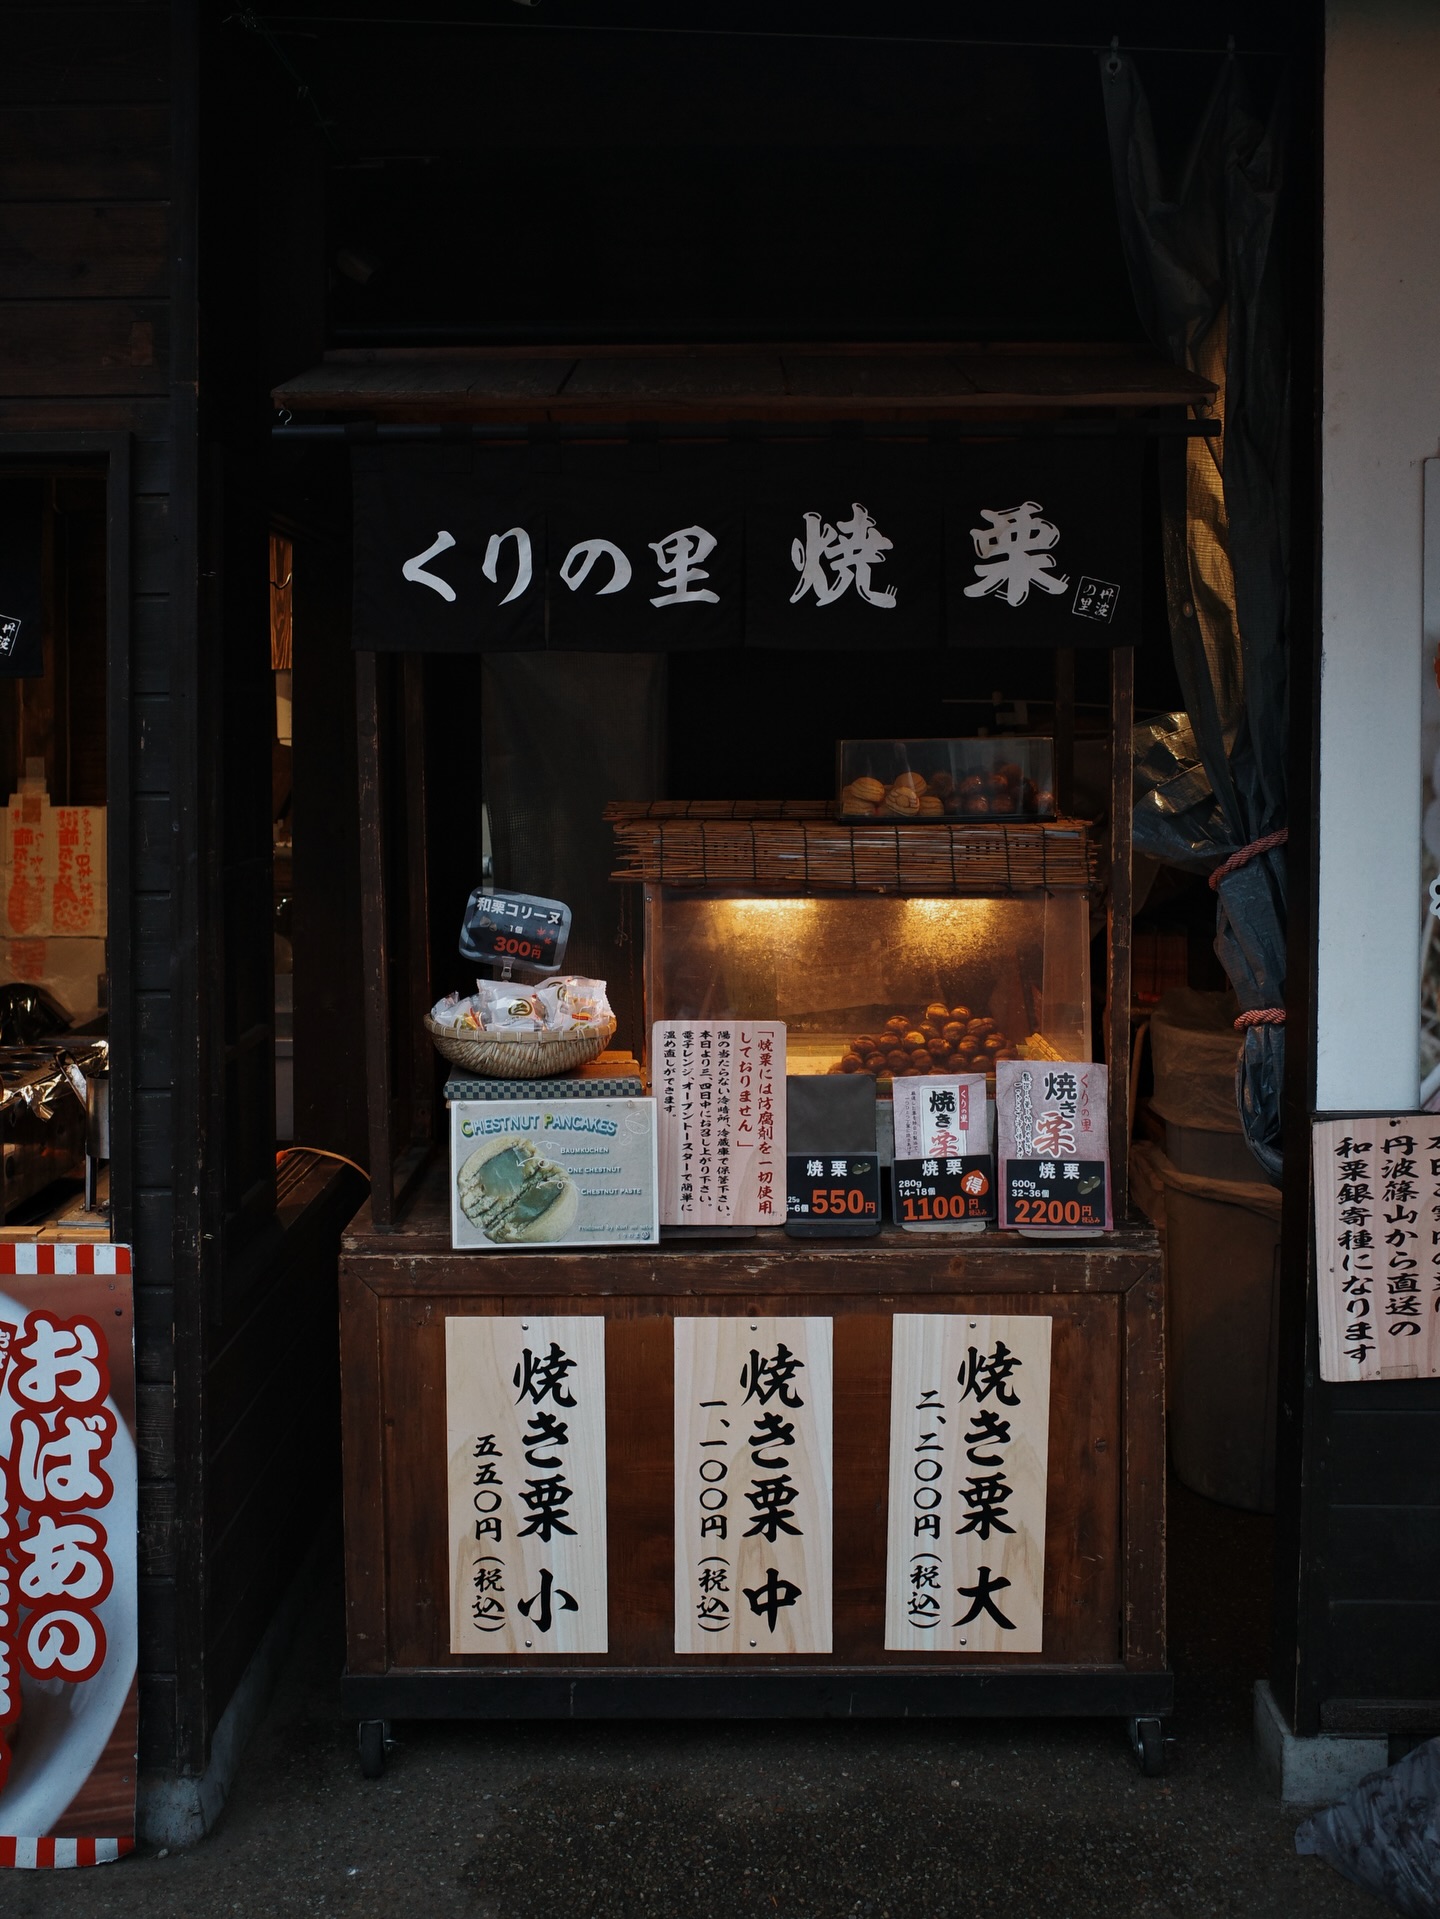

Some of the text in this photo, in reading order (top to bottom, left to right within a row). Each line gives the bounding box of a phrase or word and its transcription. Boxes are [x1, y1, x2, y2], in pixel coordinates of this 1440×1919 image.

[402, 501, 1070, 608] くりの里 焼栗
[1094, 587, 1114, 617] 丹波
[476, 897, 561, 926] 和栗コリーヌ
[493, 935, 542, 960] 300円
[664, 1031, 676, 1116] 温め直しができます。
[737, 1031, 754, 1147] しておりません」
[461, 1113, 618, 1137] CHESTNUT PANCAKES
[757, 1031, 774, 1214] 「焼栗には防腐剤を一切使用
[958, 1089, 969, 1123] くりの里
[1033, 1071, 1078, 1157] 焼き栗
[1080, 1073, 1094, 1133] くりの里
[807, 1160, 847, 1177] 焼栗
[898, 1179, 923, 1189] 280g
[922, 1158, 963, 1177] 焼栗
[967, 1176, 983, 1194] 得
[1012, 1179, 1036, 1190] 600g
[1039, 1162, 1079, 1179] 焼栗
[813, 1190, 875, 1213] 550円
[1333, 1137, 1376, 1363] 和栗銀寄種になります
[1381, 1136, 1422, 1336] 丹波篠山から直送の
[18, 1318, 108, 1674] おばあの
[513, 1342, 578, 1632] 焼き栗 小
[740, 1343, 804, 1633] 焼き栗 中
[953, 1341, 1022, 1629] 焼き栗 大
